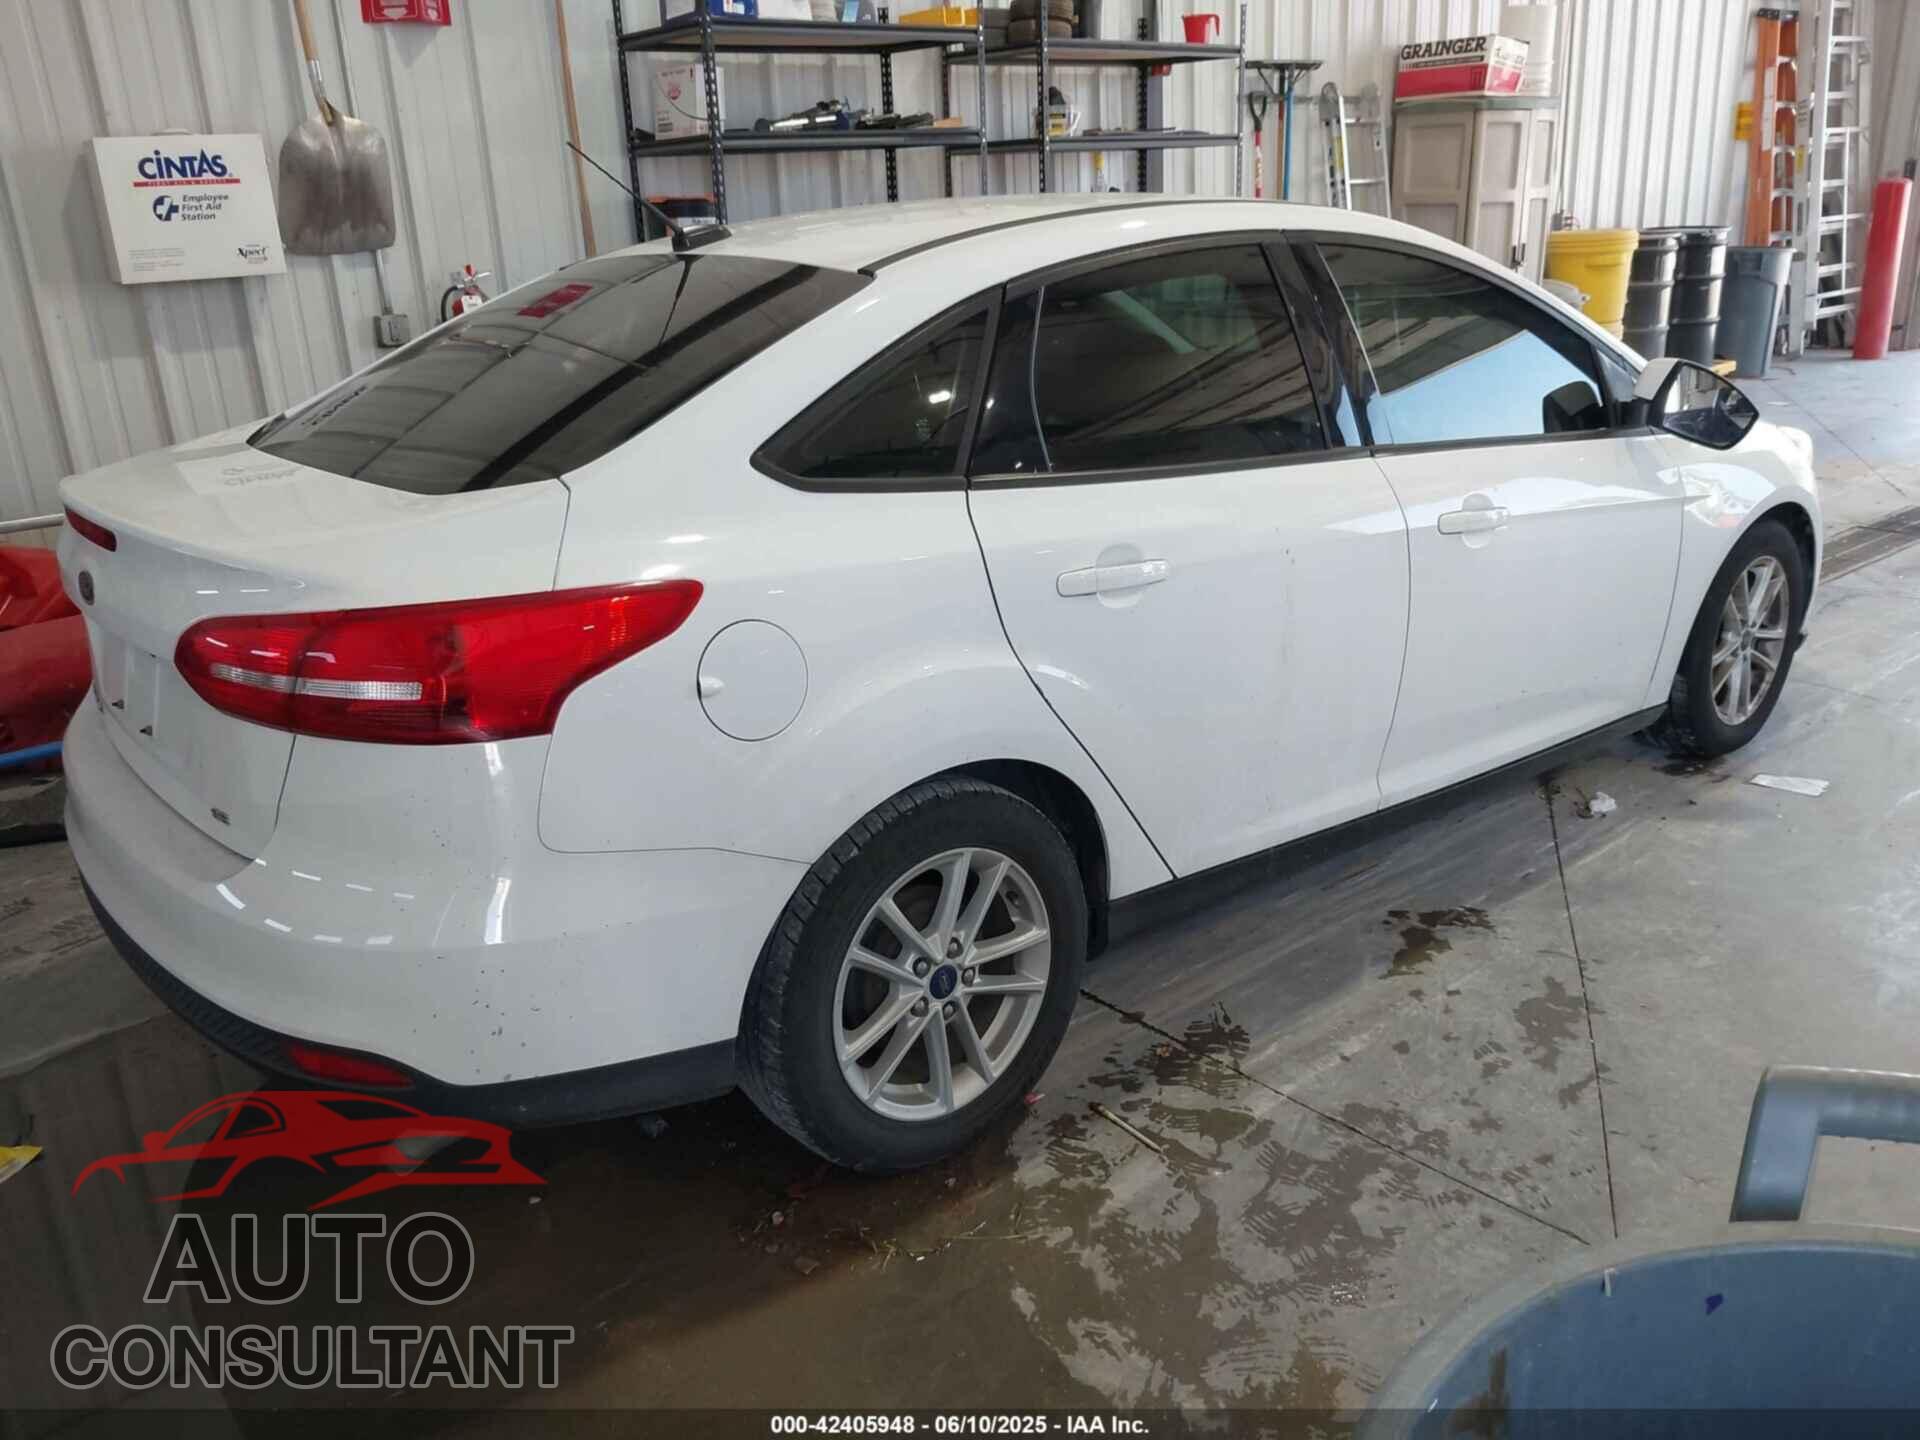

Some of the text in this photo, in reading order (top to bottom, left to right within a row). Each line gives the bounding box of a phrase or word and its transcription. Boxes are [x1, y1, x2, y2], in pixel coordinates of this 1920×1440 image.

[1400, 36, 1487, 60] GRAINGER
[182, 193, 229, 203] Employee
[182, 202, 222, 212] First Aid
[181, 213, 216, 221] Station
